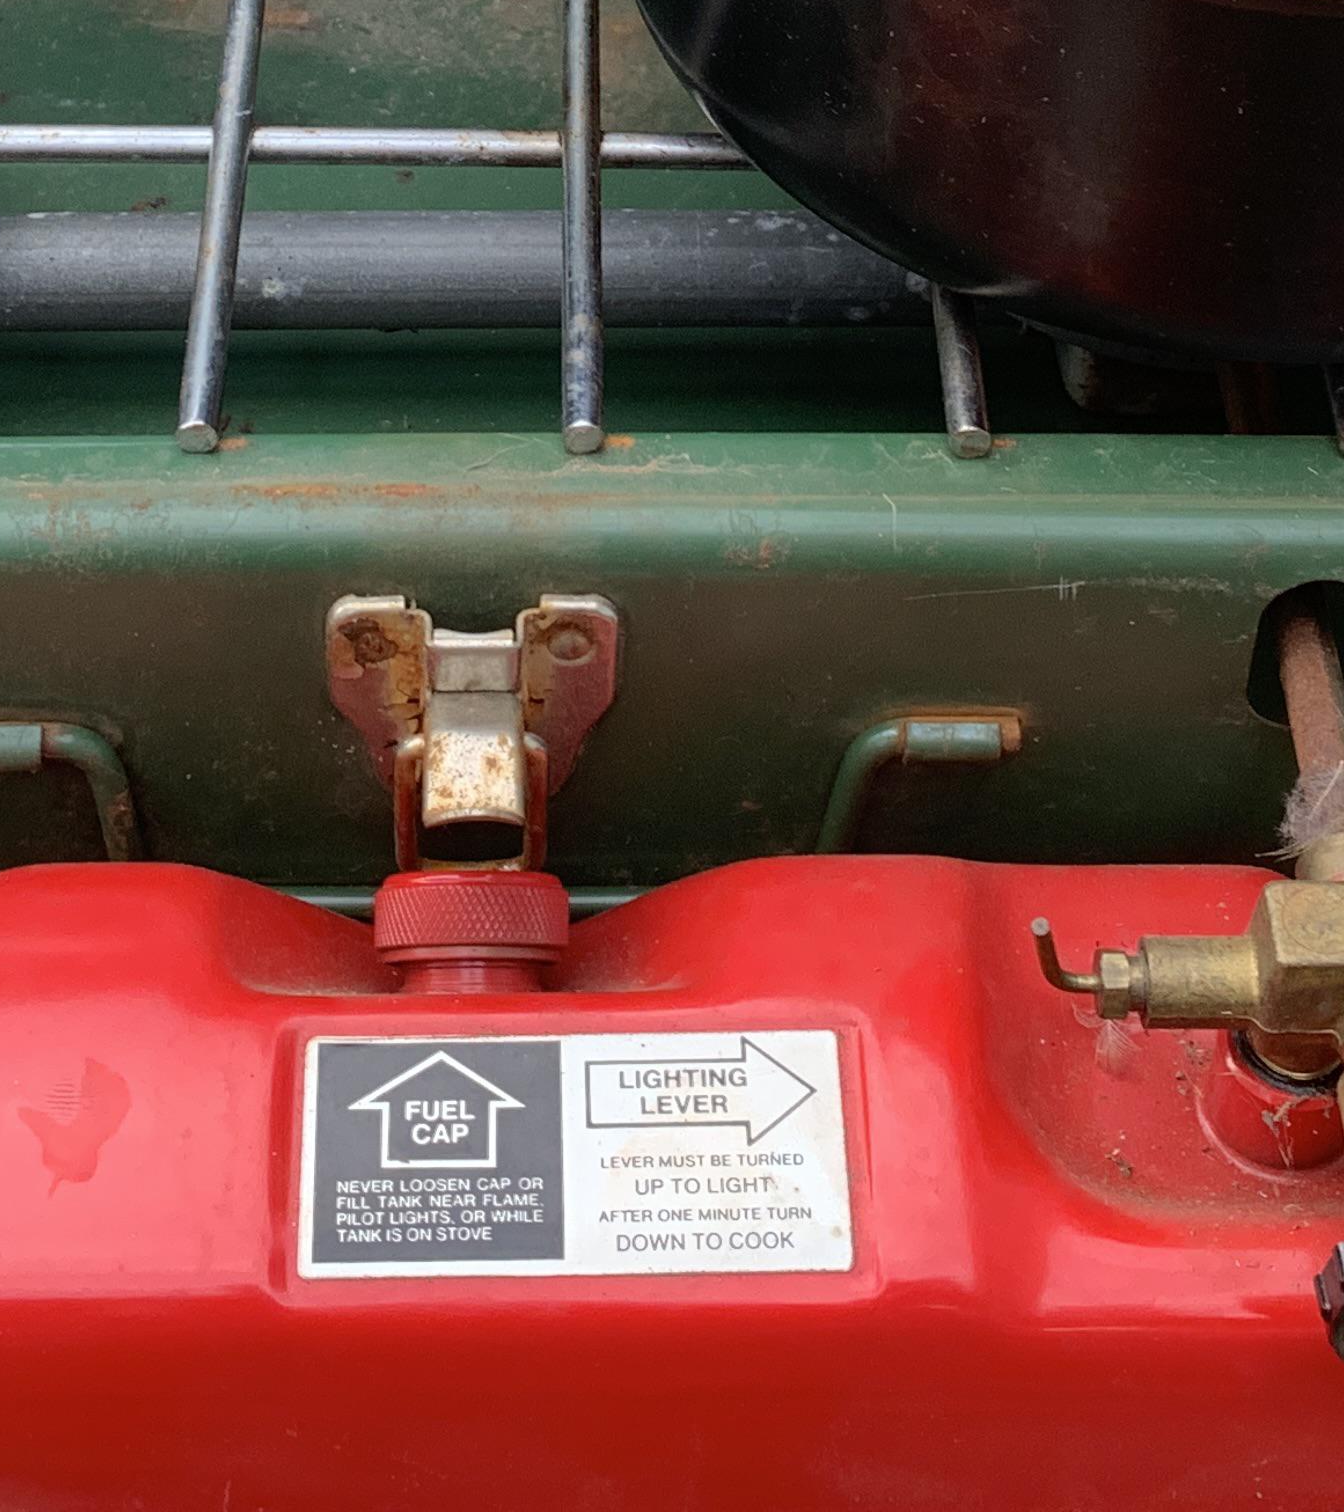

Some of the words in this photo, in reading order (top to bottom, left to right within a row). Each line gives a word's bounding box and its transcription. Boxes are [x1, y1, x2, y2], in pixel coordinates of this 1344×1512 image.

[618, 1068, 748, 1089] LIGHTING
[405, 1100, 475, 1121] FUEL
[641, 1095, 728, 1114] LEVER
[412, 1123, 469, 1144] CAP
[601, 1156, 654, 1168] LEVER
[659, 1155, 704, 1167] MUST
[711, 1155, 731, 1166] BE
[737, 1154, 805, 1167] TURNED
[337, 1180, 393, 1193] NEVER
[400, 1178, 470, 1192] LOOSEN
[477, 1178, 511, 1191] CAP
[518, 1177, 544, 1190] OR
[635, 1179, 664, 1195] UP
[671, 1178, 700, 1194] TO
[708, 1176, 770, 1193] LIGHT
[337, 1197, 370, 1209] FILL
[378, 1196, 422, 1208] TANK
[430, 1194, 476, 1207] NEAR
[337, 1212, 384, 1225] PILOT
[461, 1210, 485, 1223] OR
[491, 1210, 543, 1222] WHILE
[599, 1210, 652, 1222] AFTER
[658, 1209, 693, 1222] ONE
[698, 1208, 761, 1221] MINUTE
[767, 1207, 811, 1220] TURN
[337, 1229, 382, 1242] TANK
[386, 1228, 402, 1242] IS
[407, 1228, 432, 1241] ON
[436, 1227, 492, 1241] STOVE
[616, 1234, 685, 1252] DOWN
[692, 1233, 722, 1250] TO
[729, 1232, 794, 1249] COOK
